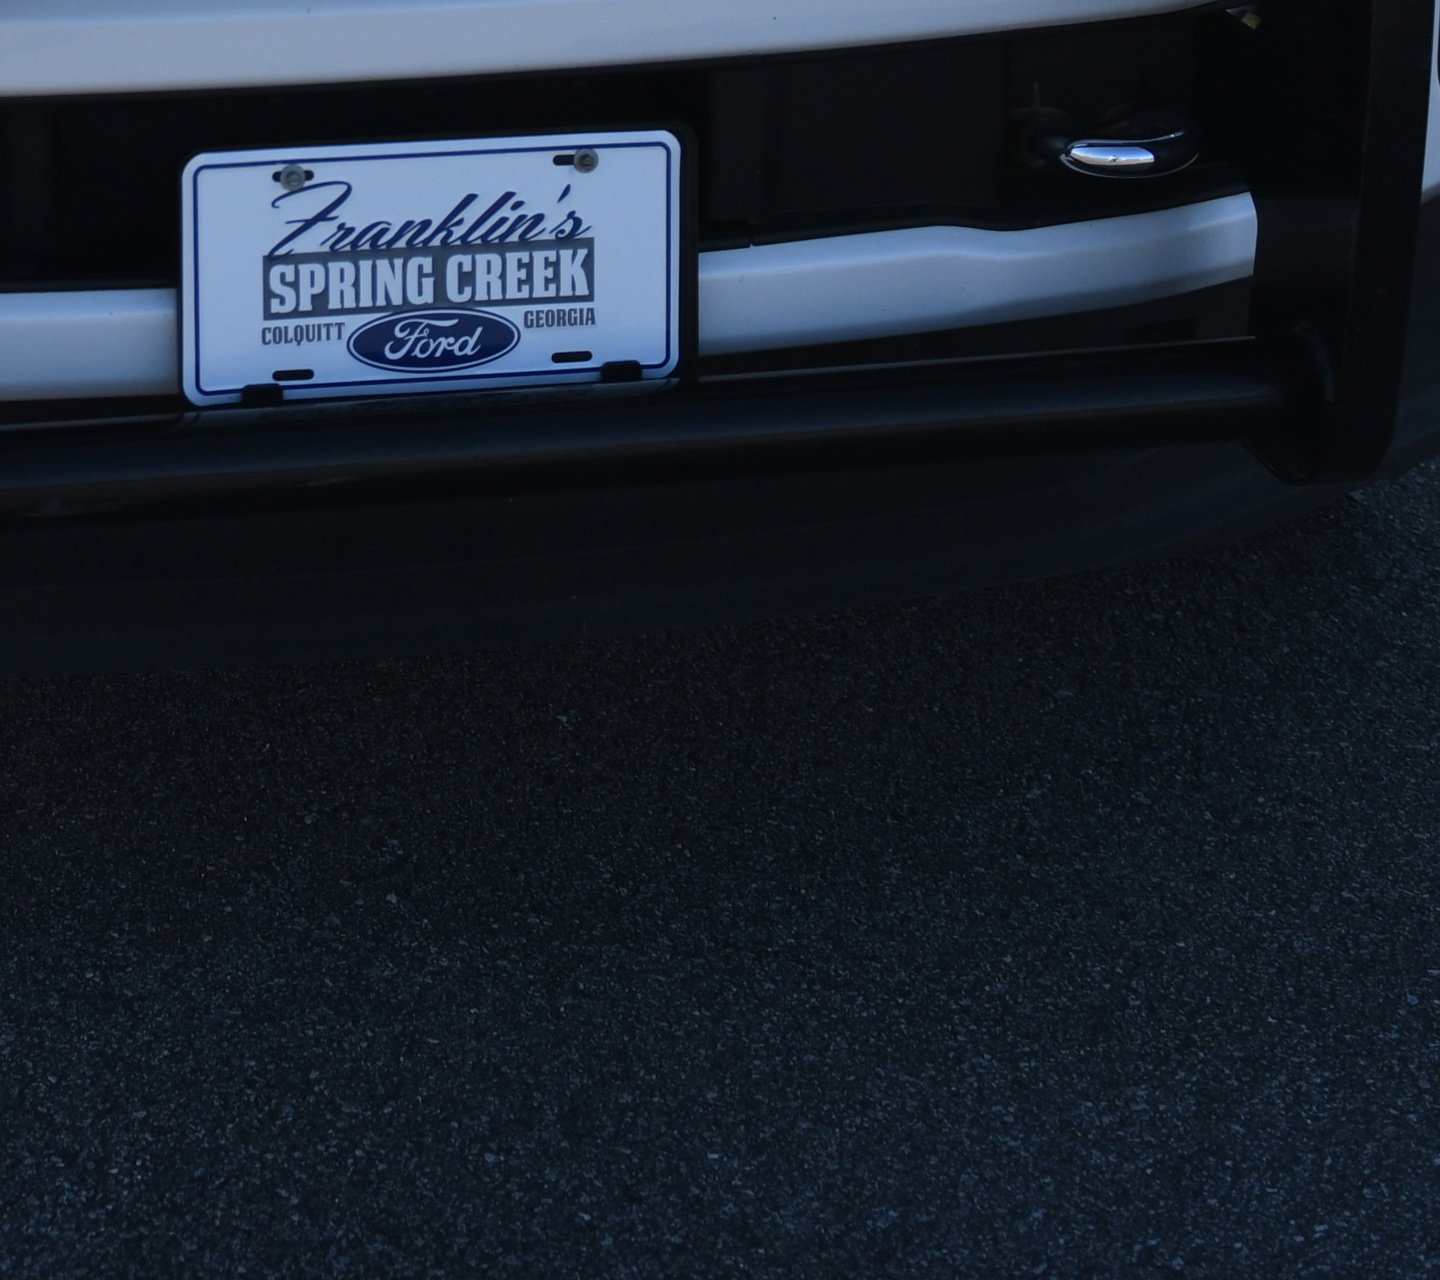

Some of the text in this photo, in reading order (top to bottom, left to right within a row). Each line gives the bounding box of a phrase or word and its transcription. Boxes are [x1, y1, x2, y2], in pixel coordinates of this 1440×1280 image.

[268, 180, 592, 256] Franklin's
[268, 248, 590, 315] SPRING CREEK
[261, 321, 346, 347] COLQUITT
[384, 317, 484, 361] Ford
[523, 307, 597, 330] GEORGIA
